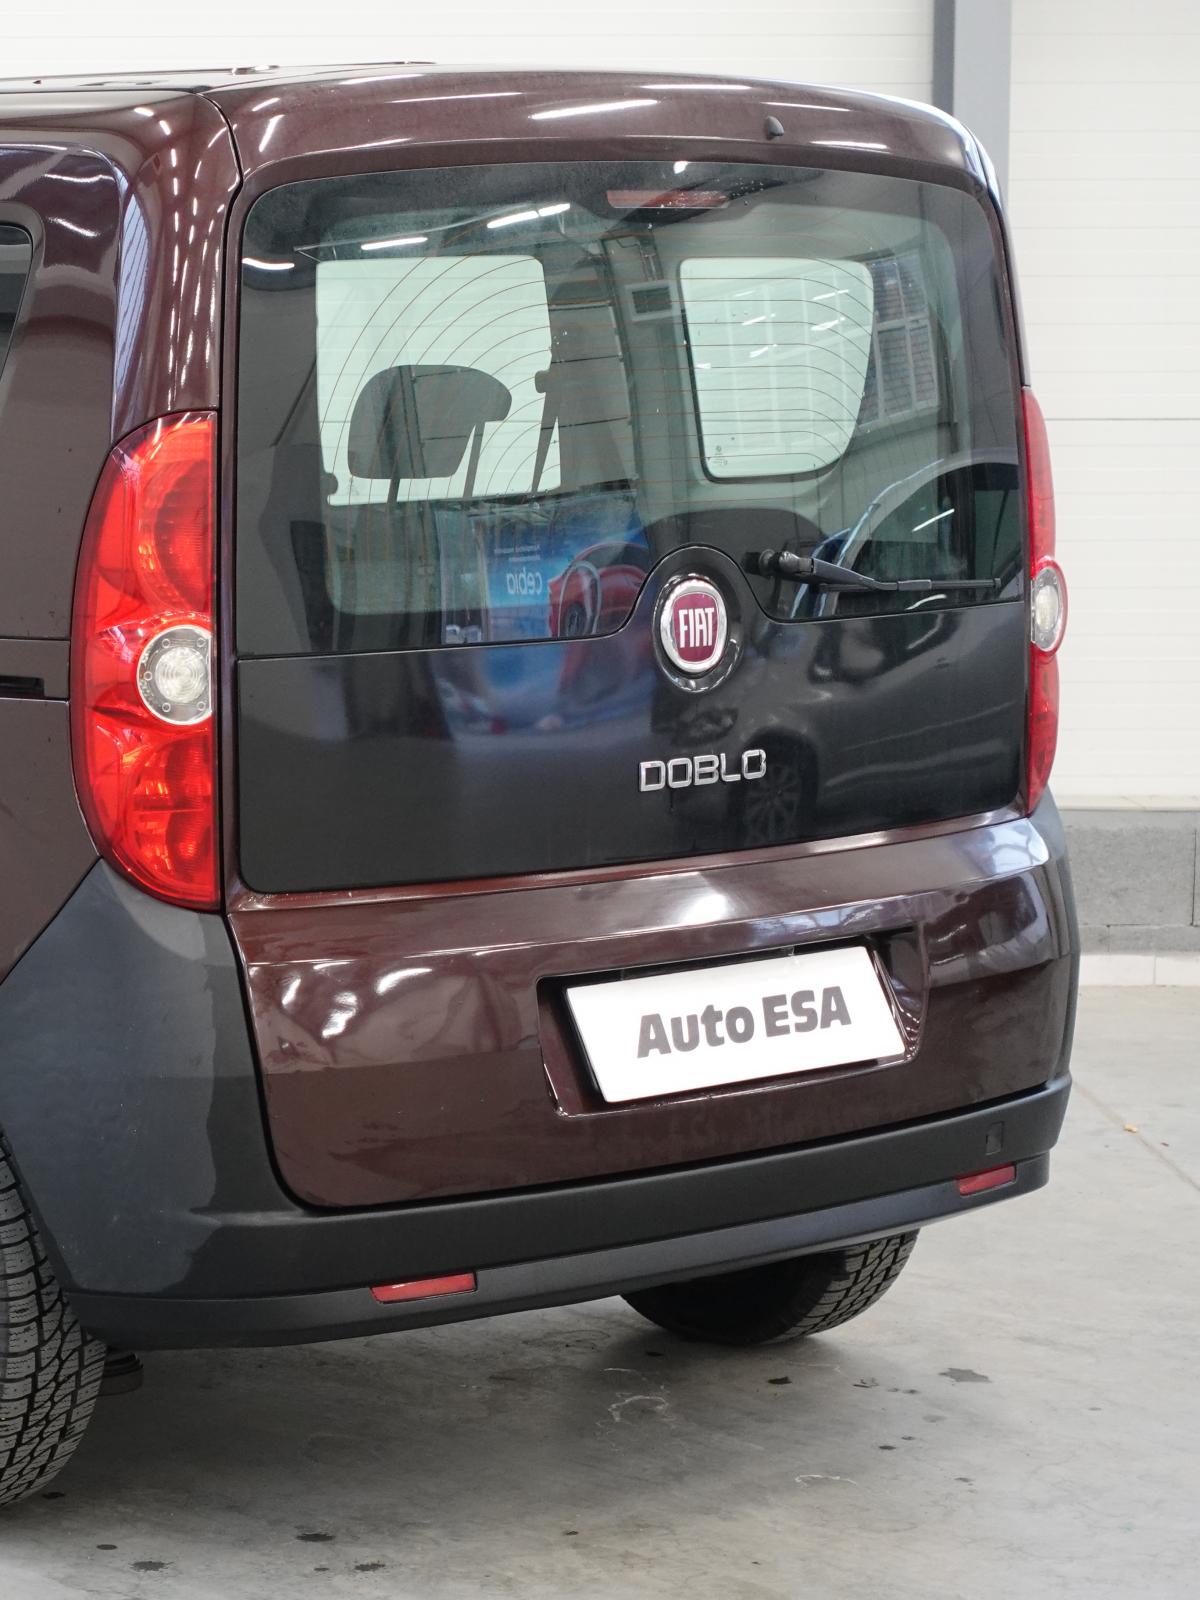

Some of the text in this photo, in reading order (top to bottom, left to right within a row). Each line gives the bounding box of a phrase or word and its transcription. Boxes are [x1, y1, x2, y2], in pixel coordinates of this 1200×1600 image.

[678, 607, 715, 649] FIAT
[639, 748, 767, 792] DOBLO
[637, 985, 852, 1058] Auto ESA
